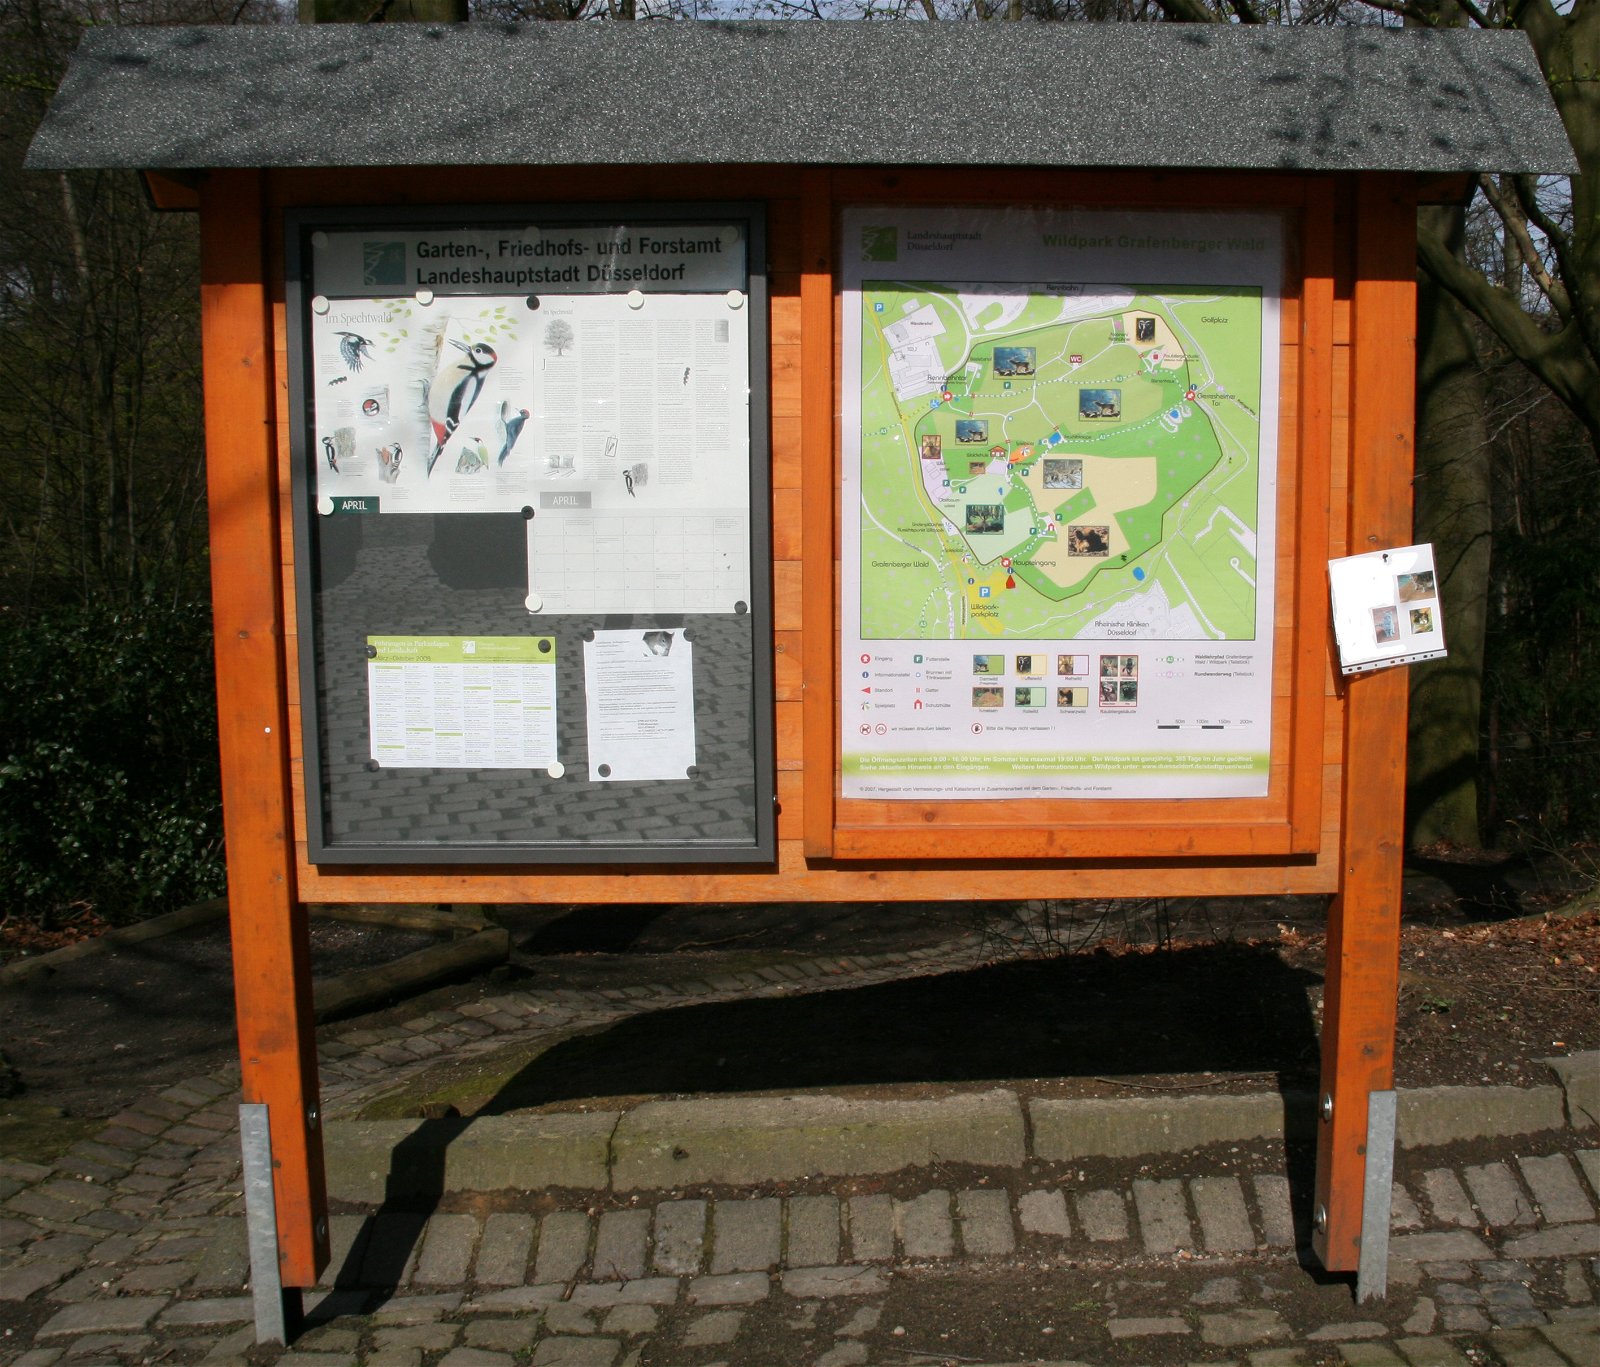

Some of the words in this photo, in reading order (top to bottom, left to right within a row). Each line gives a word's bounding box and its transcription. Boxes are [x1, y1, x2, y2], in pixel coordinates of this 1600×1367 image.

[907, 231, 982, 241] Landeshauptstadt
[416, 241, 490, 260] Garten-,
[498, 239, 590, 257] Friedhofs-
[597, 238, 632, 254] und
[640, 237, 722, 254] Forstamt
[907, 242, 953, 251] Düsseldorf
[1042, 234, 1114, 249] Wildpark
[1118, 236, 1222, 252] Grafenberger
[1227, 238, 1265, 250] Wald
[416, 266, 580, 287] Landeshauptstadt
[587, 263, 685, 282] Düsseldorf
[326, 314, 339, 324] Im
[340, 311, 393, 326] Spechtwald
[342, 500, 368, 510] APRIL
[552, 495, 579, 505] APRIL
